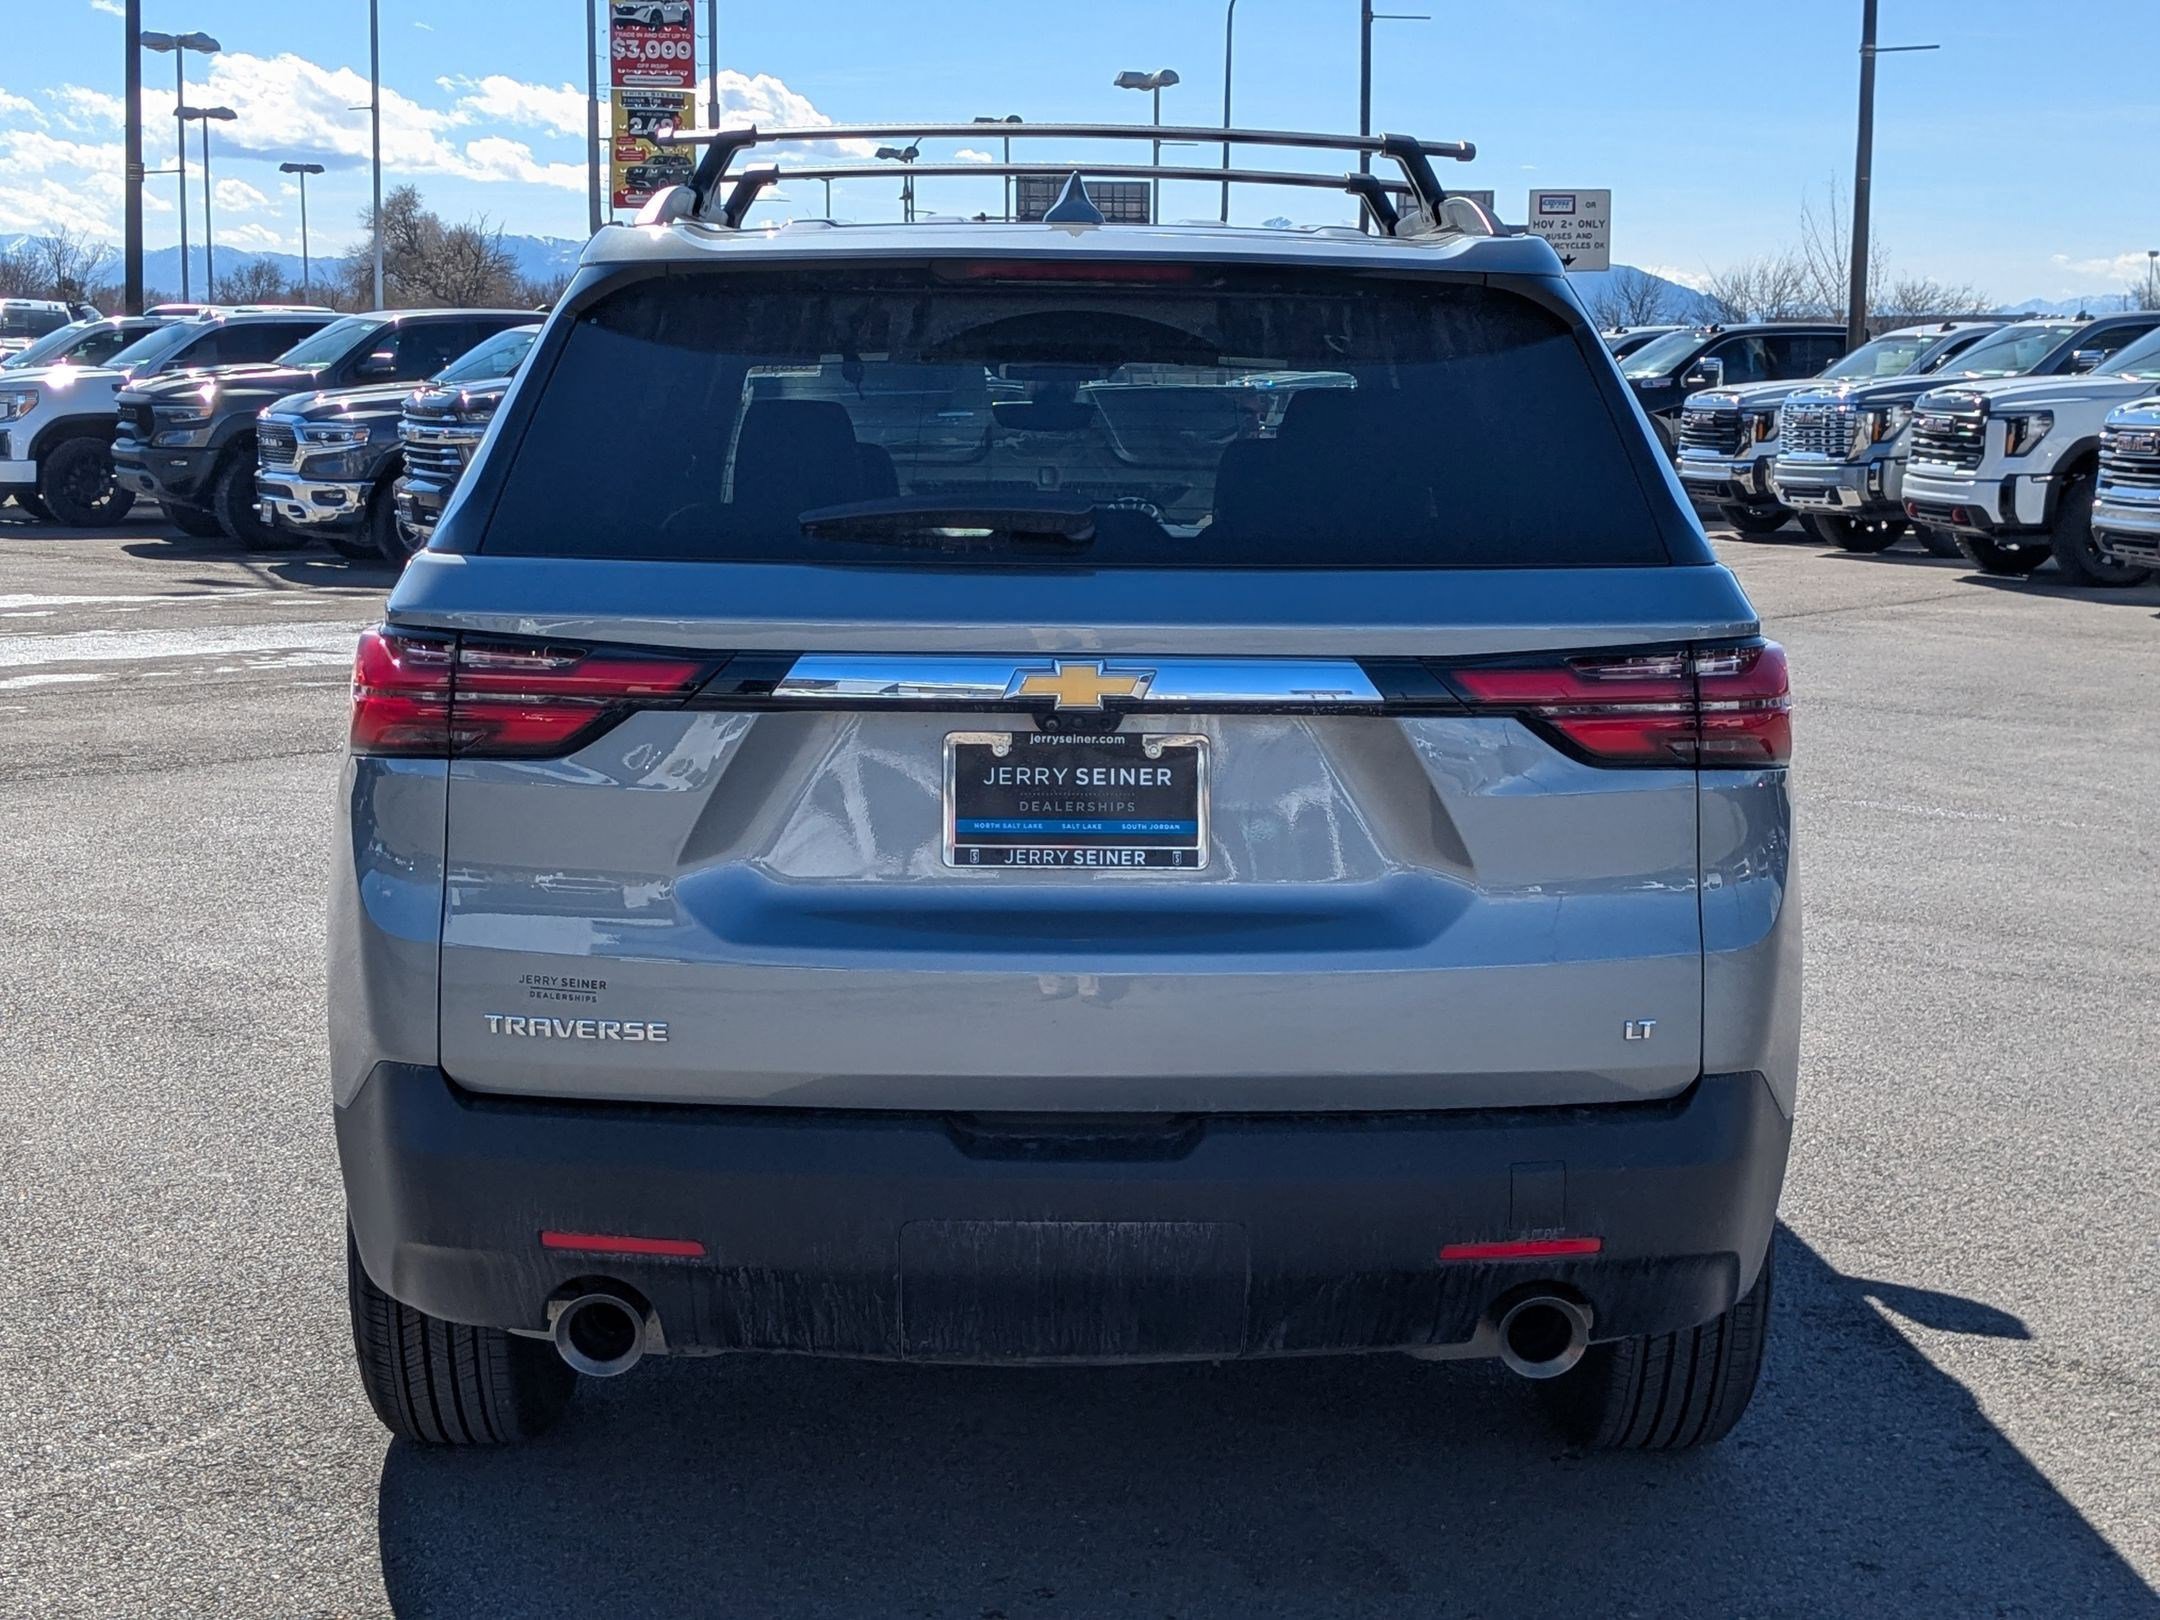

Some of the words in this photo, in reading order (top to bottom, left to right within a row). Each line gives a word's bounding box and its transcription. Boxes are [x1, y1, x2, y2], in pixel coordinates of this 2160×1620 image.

[612, 37, 691, 62] $3,000
[1533, 220, 1554, 229] HOV
[1578, 219, 1606, 229] ONLY
[1030, 733, 1126, 745] jerryseiner.com
[983, 767, 1068, 786] JERRY
[1075, 768, 1172, 786] SEINER
[1020, 801, 1136, 812] DEALERSHIPS
[1004, 850, 1068, 865] JERRY
[1073, 850, 1146, 865] SEINER
[519, 974, 558, 986] JERRY
[561, 977, 607, 990] SEINER
[529, 990, 597, 1003] DEALERSHIPS
[484, 1014, 670, 1043] TRAVERSE
[1624, 1019, 1657, 1040] LT
